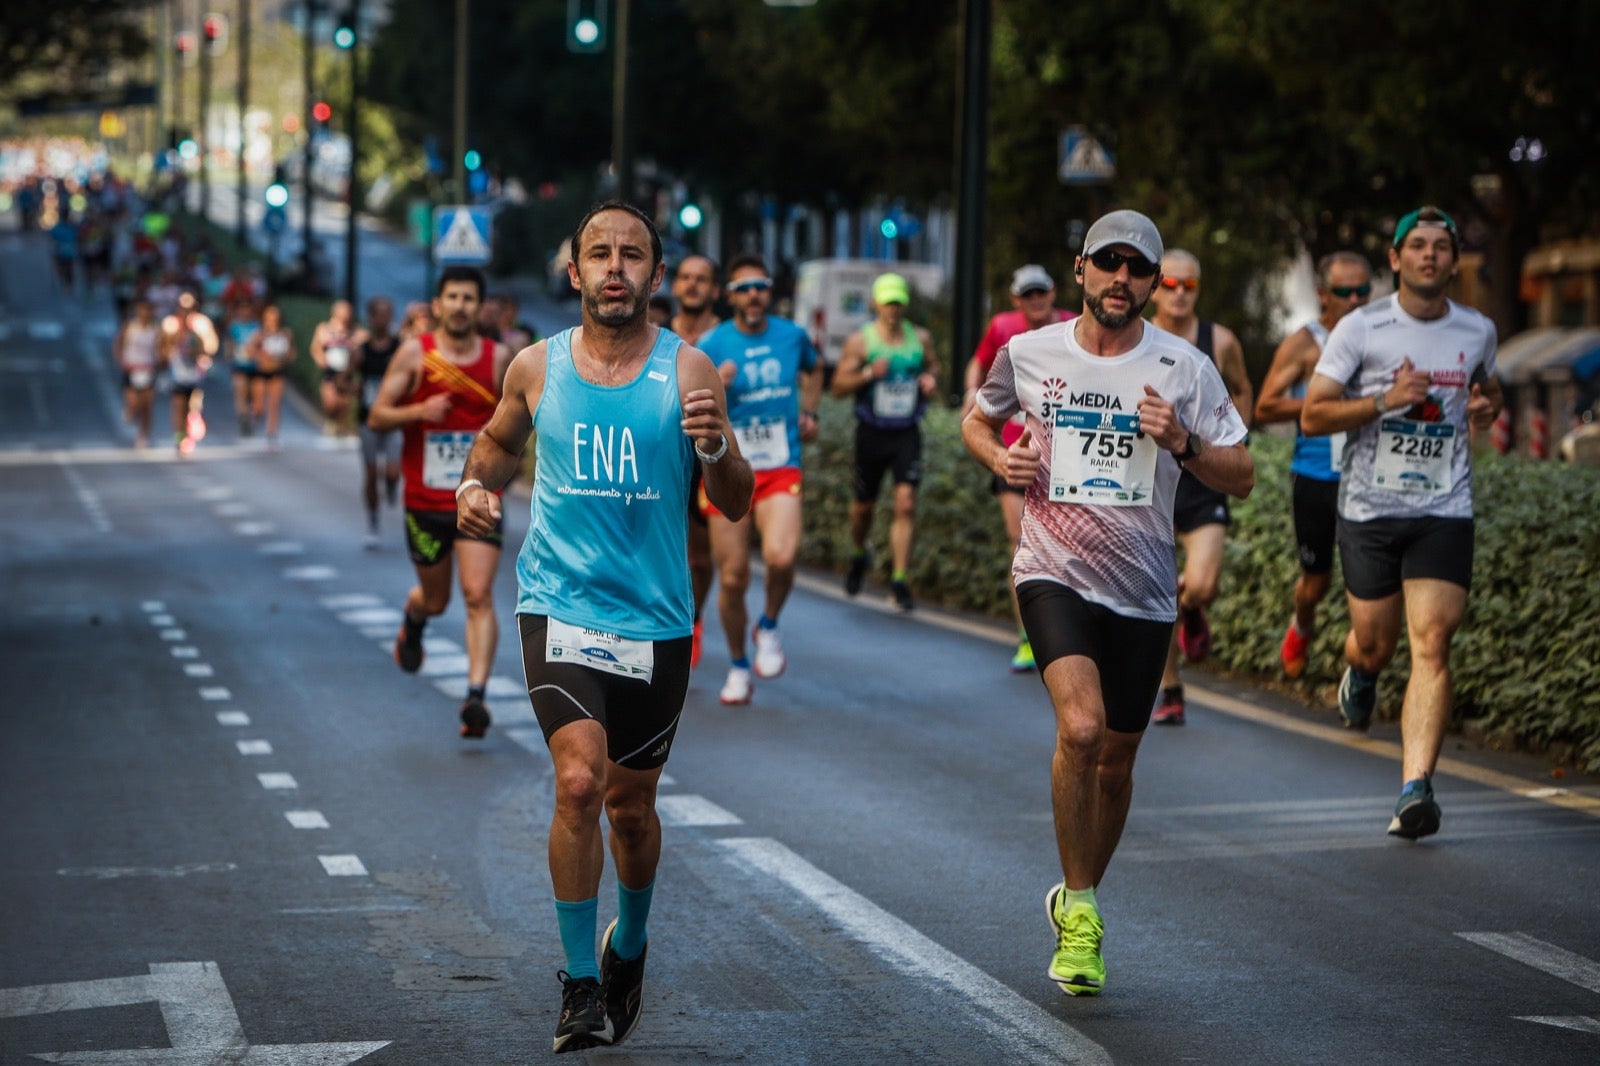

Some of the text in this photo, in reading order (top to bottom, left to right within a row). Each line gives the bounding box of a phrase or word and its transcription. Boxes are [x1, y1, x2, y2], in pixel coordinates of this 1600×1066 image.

[1069, 391, 1122, 411] MEDIA
[573, 422, 639, 484] ENA
[1079, 431, 1134, 459] 755
[1390, 434, 1444, 458] 2282
[1090, 458, 1120, 469] RAFAEL
[624, 491, 633, 506] y
[635, 486, 661, 500] salud
[582, 627, 605, 639] JUAN
